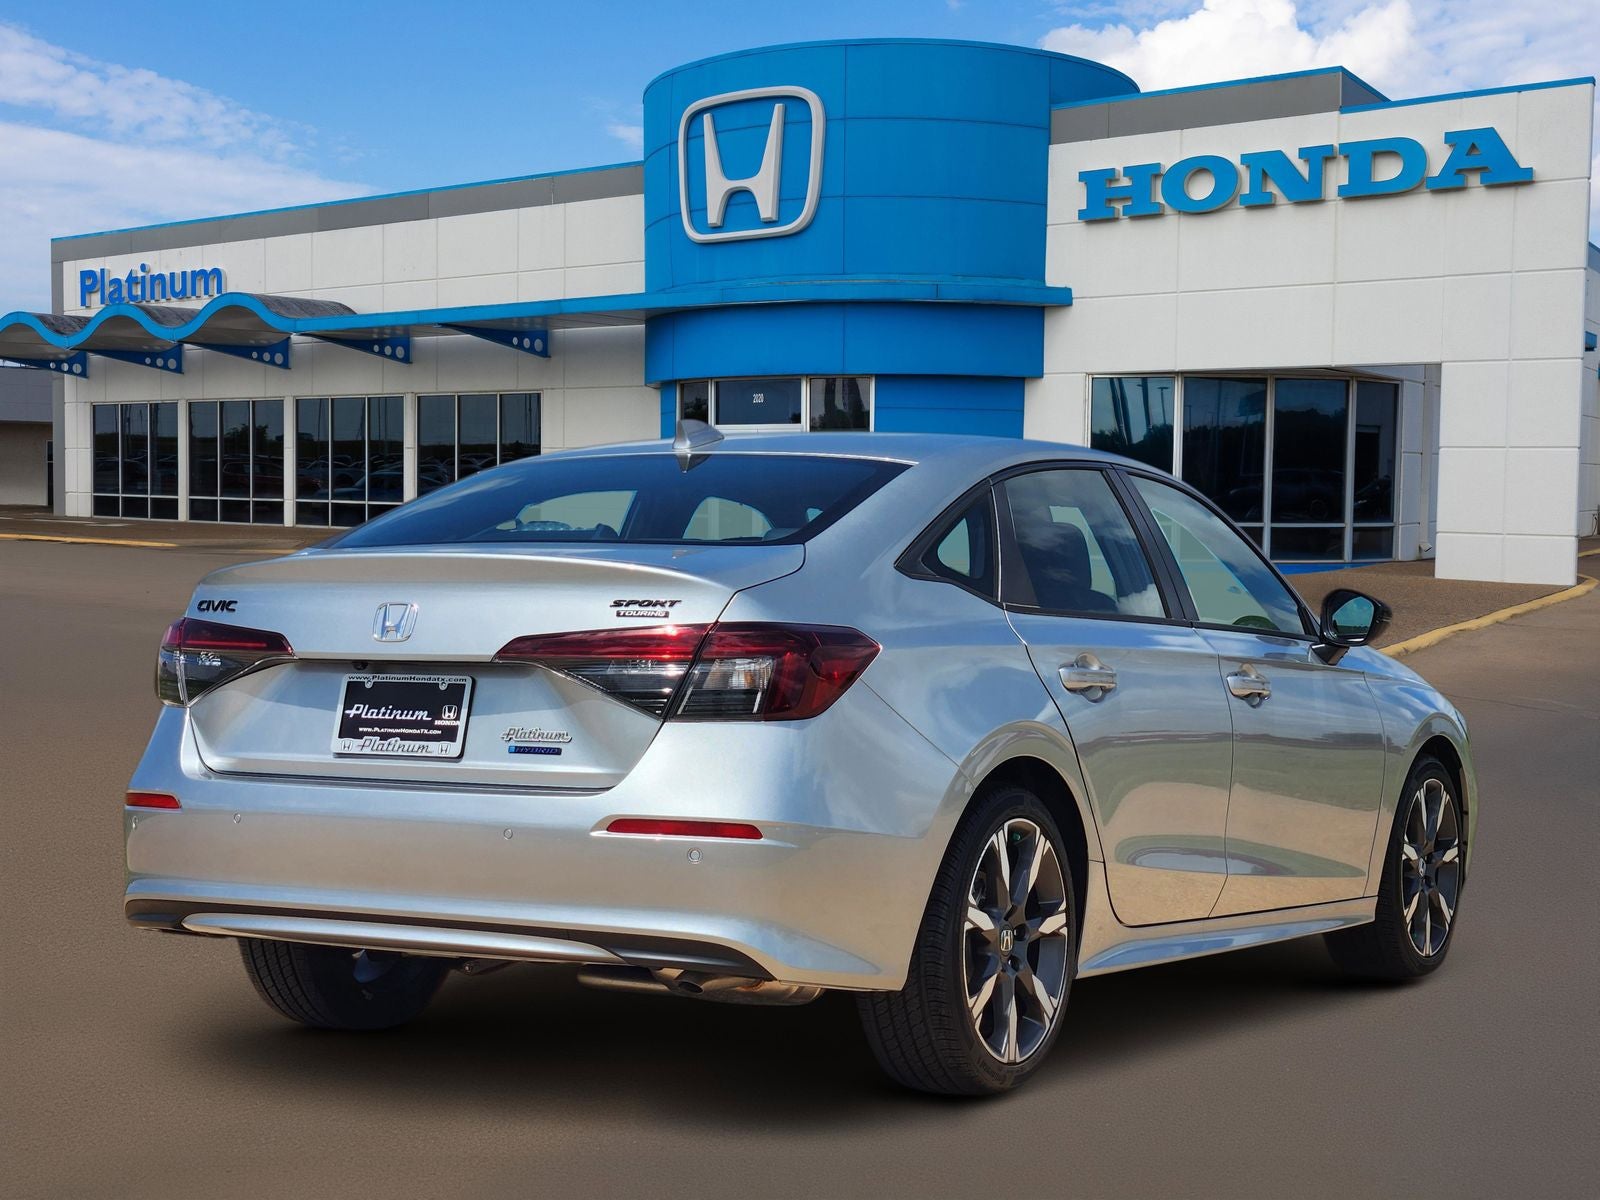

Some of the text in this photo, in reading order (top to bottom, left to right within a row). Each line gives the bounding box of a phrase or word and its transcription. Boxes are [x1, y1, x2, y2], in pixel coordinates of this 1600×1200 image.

[1078, 126, 1534, 222] HONDA
[79, 262, 225, 308] Platinum
[197, 599, 238, 612] CIVIC
[610, 599, 682, 608] SPORT
[348, 674, 467, 683] www.PlatinumHondatx.com
[345, 704, 432, 720] Platinum
[501, 727, 572, 743] Platinum
[357, 737, 433, 754] Platinum
[515, 746, 559, 755] HYBRID
